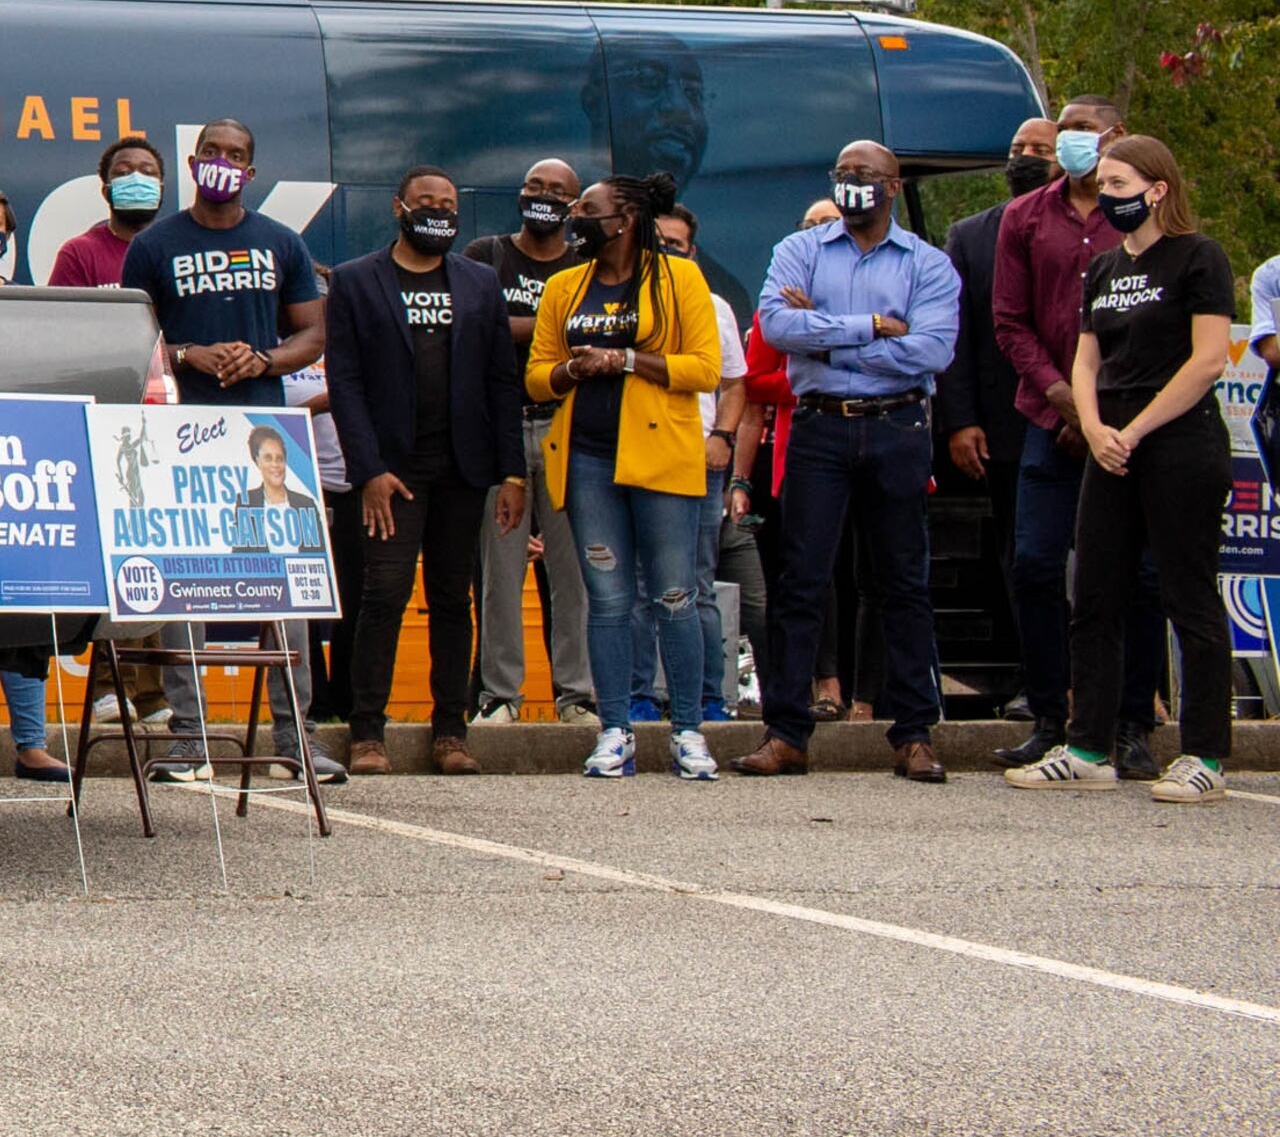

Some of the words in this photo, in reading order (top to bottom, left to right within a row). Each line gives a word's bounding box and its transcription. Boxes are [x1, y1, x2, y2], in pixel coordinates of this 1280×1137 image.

[198, 163, 241, 192] VOTE
[531, 203, 552, 212] VOTE
[427, 218, 449, 228] VOTE
[173, 249, 274, 277] BIDEN
[176, 271, 276, 297] HARRIS
[518, 275, 546, 294] VOT
[1111, 274, 1148, 292] VOTE
[401, 292, 452, 306] VOTE
[177, 416, 227, 454] Elect
[172, 465, 249, 505] PATSY
[113, 507, 320, 547] AUSTIN-GATSON
[1218, 545, 1264, 555] den.com
[164, 556, 220, 574] DISTRICT
[222, 558, 281, 574] ATTORNEY
[287, 564, 307, 574] EARLY
[308, 564, 326, 575] VOTE
[122, 566, 156, 583] VOTE
[126, 586, 149, 602] NOV
[151, 587, 159, 601] 3
[169, 582, 232, 599] Gwinnett
[235, 582, 283, 602] County
